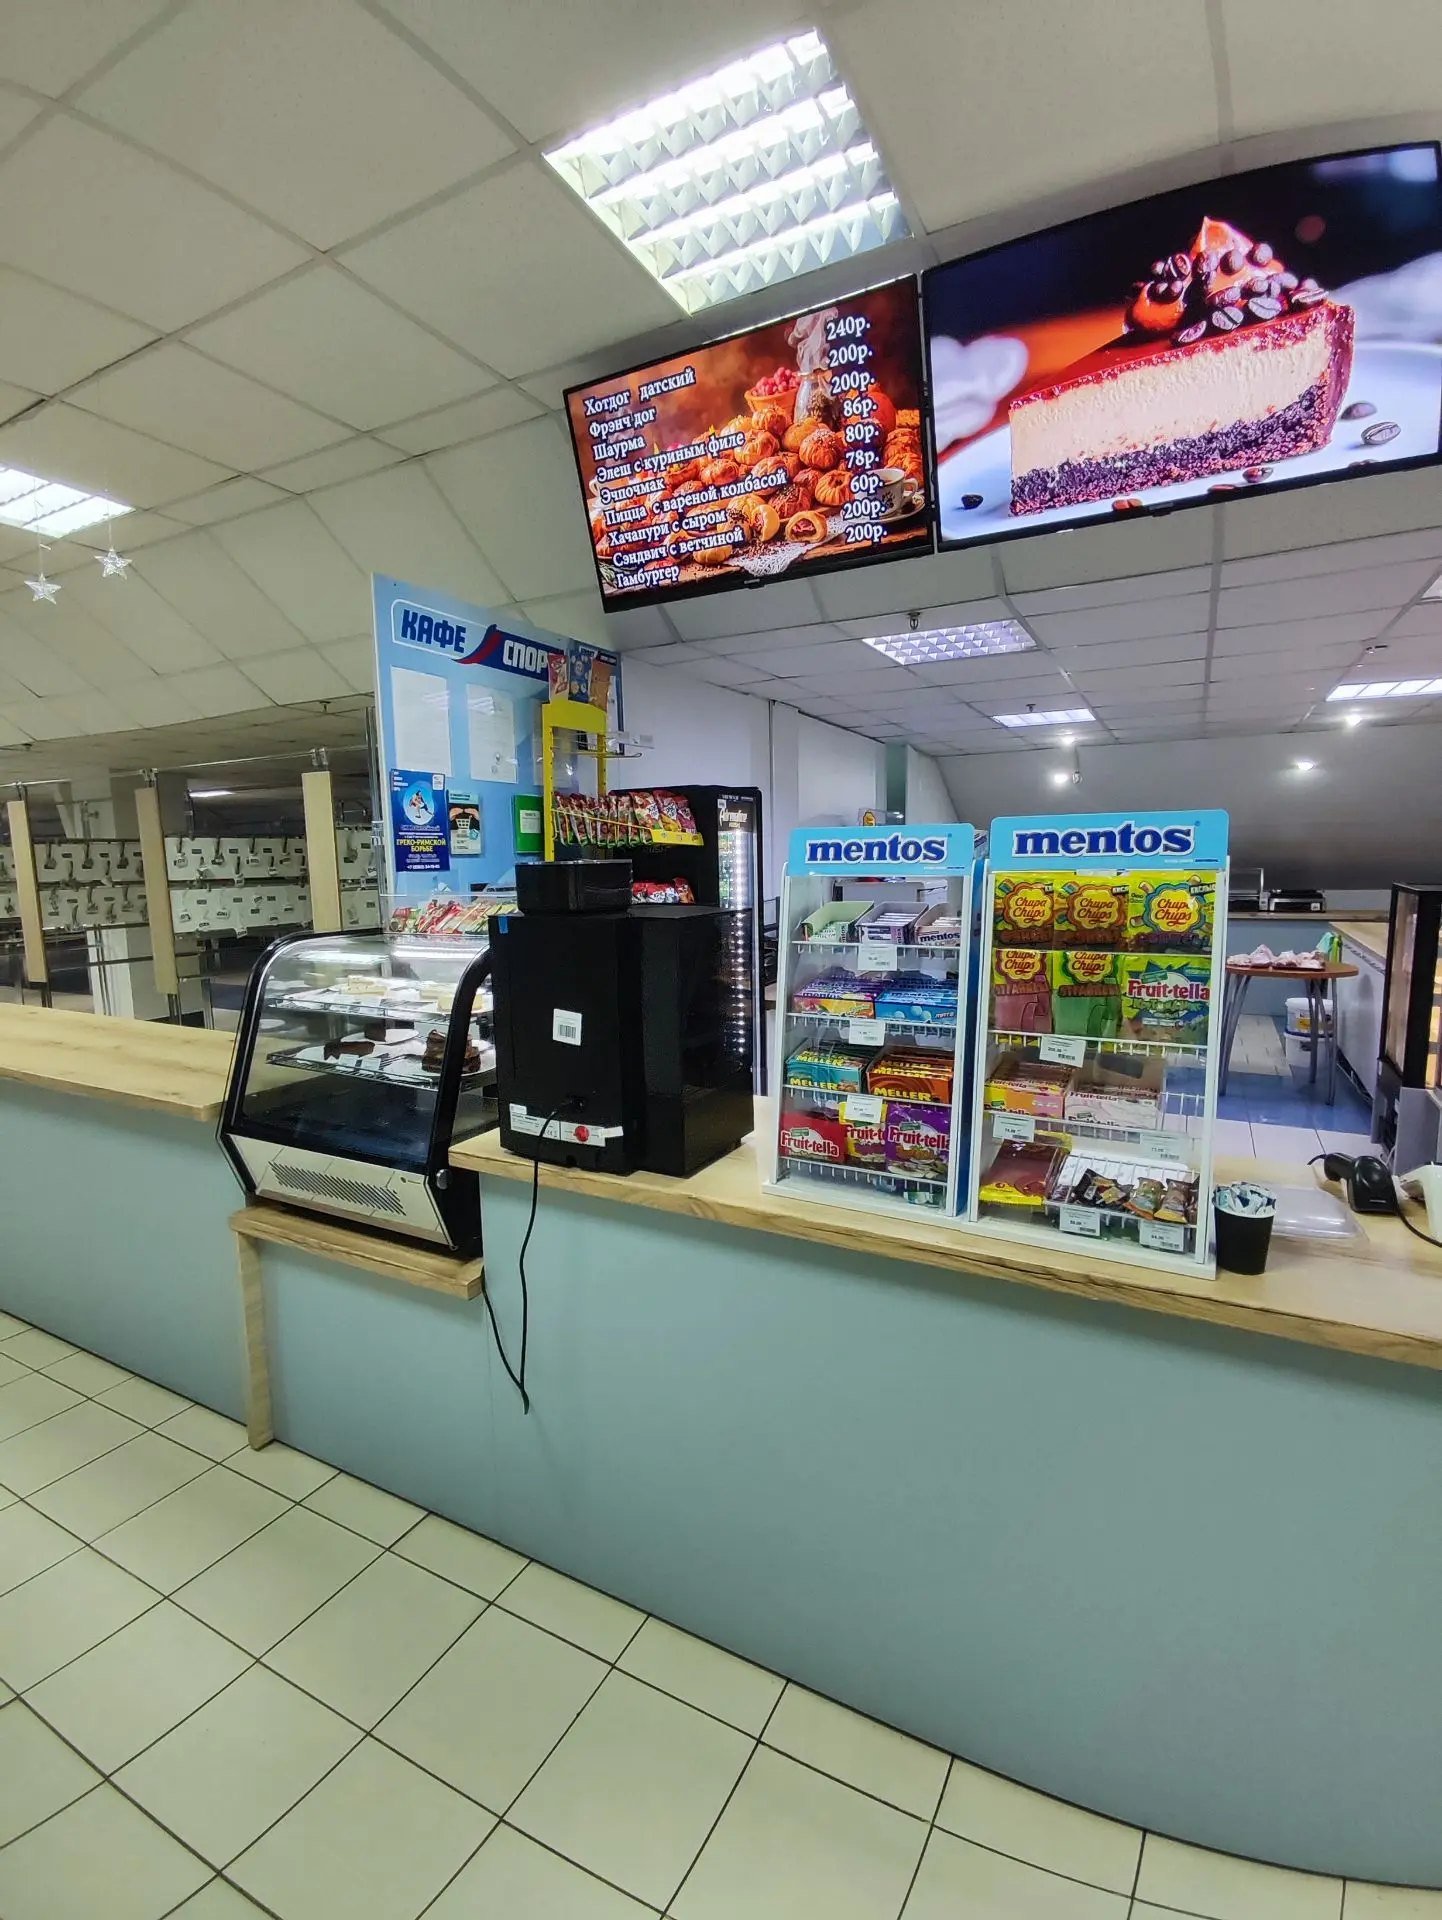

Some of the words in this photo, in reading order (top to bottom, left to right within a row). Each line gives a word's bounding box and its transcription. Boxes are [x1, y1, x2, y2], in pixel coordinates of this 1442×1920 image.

[827, 316, 871, 340] 240р.
[829, 344, 873, 367] 200р.
[585, 390, 630, 416] Хотдог
[640, 368, 695, 401] датский
[831, 371, 875, 393] 200р.
[843, 397, 877, 417] 86р.
[589, 415, 631, 438] Фрэнч
[634, 408, 656, 427] дог
[846, 424, 879, 443] 80р.
[593, 436, 645, 460] Шаурма
[597, 463, 631, 482] Элеш
[634, 460, 642, 472] с
[643, 442, 706, 470] куриным
[709, 432, 745, 454] филе
[846, 450, 879, 469] 78р.
[601, 477, 664, 503] Эчпочмак
[850, 474, 883, 493] 60р.
[605, 507, 647, 525] Пицца
[653, 502, 661, 513] с
[663, 486, 717, 511] вареной
[720, 469, 787, 497] колбасой
[843, 499, 886, 519] 200р.
[609, 523, 669, 546] Хачапури
[672, 518, 680, 530] с
[682, 510, 727, 530] сыром
[845, 523, 887, 542] 200р.
[613, 546, 667, 567] Сэндвич
[670, 543, 677, 555] с
[680, 528, 744, 552] ветчиной
[617, 566, 679, 588] Гамбургер
[401, 609, 466, 653] КАФЕ
[808, 835, 946, 863] mentos
[1015, 823, 1194, 855] mentos
[1015, 896, 1047, 909] Chupa
[1080, 897, 1114, 910] Chupa
[1012, 908, 1045, 922] Chups
[1077, 908, 1112, 924] Chups
[1154, 910, 1192, 926] Chups
[919, 932, 960, 943] mentos
[1004, 959, 1035, 975] Chups
[1071, 959, 1105, 976] Chups
[1128, 980, 1210, 1000] Fruit-tella
[790, 1077, 838, 1091] MELLER
[874, 1087, 931, 1102] MELLER
[782, 1131, 838, 1156] Fruit-tella
